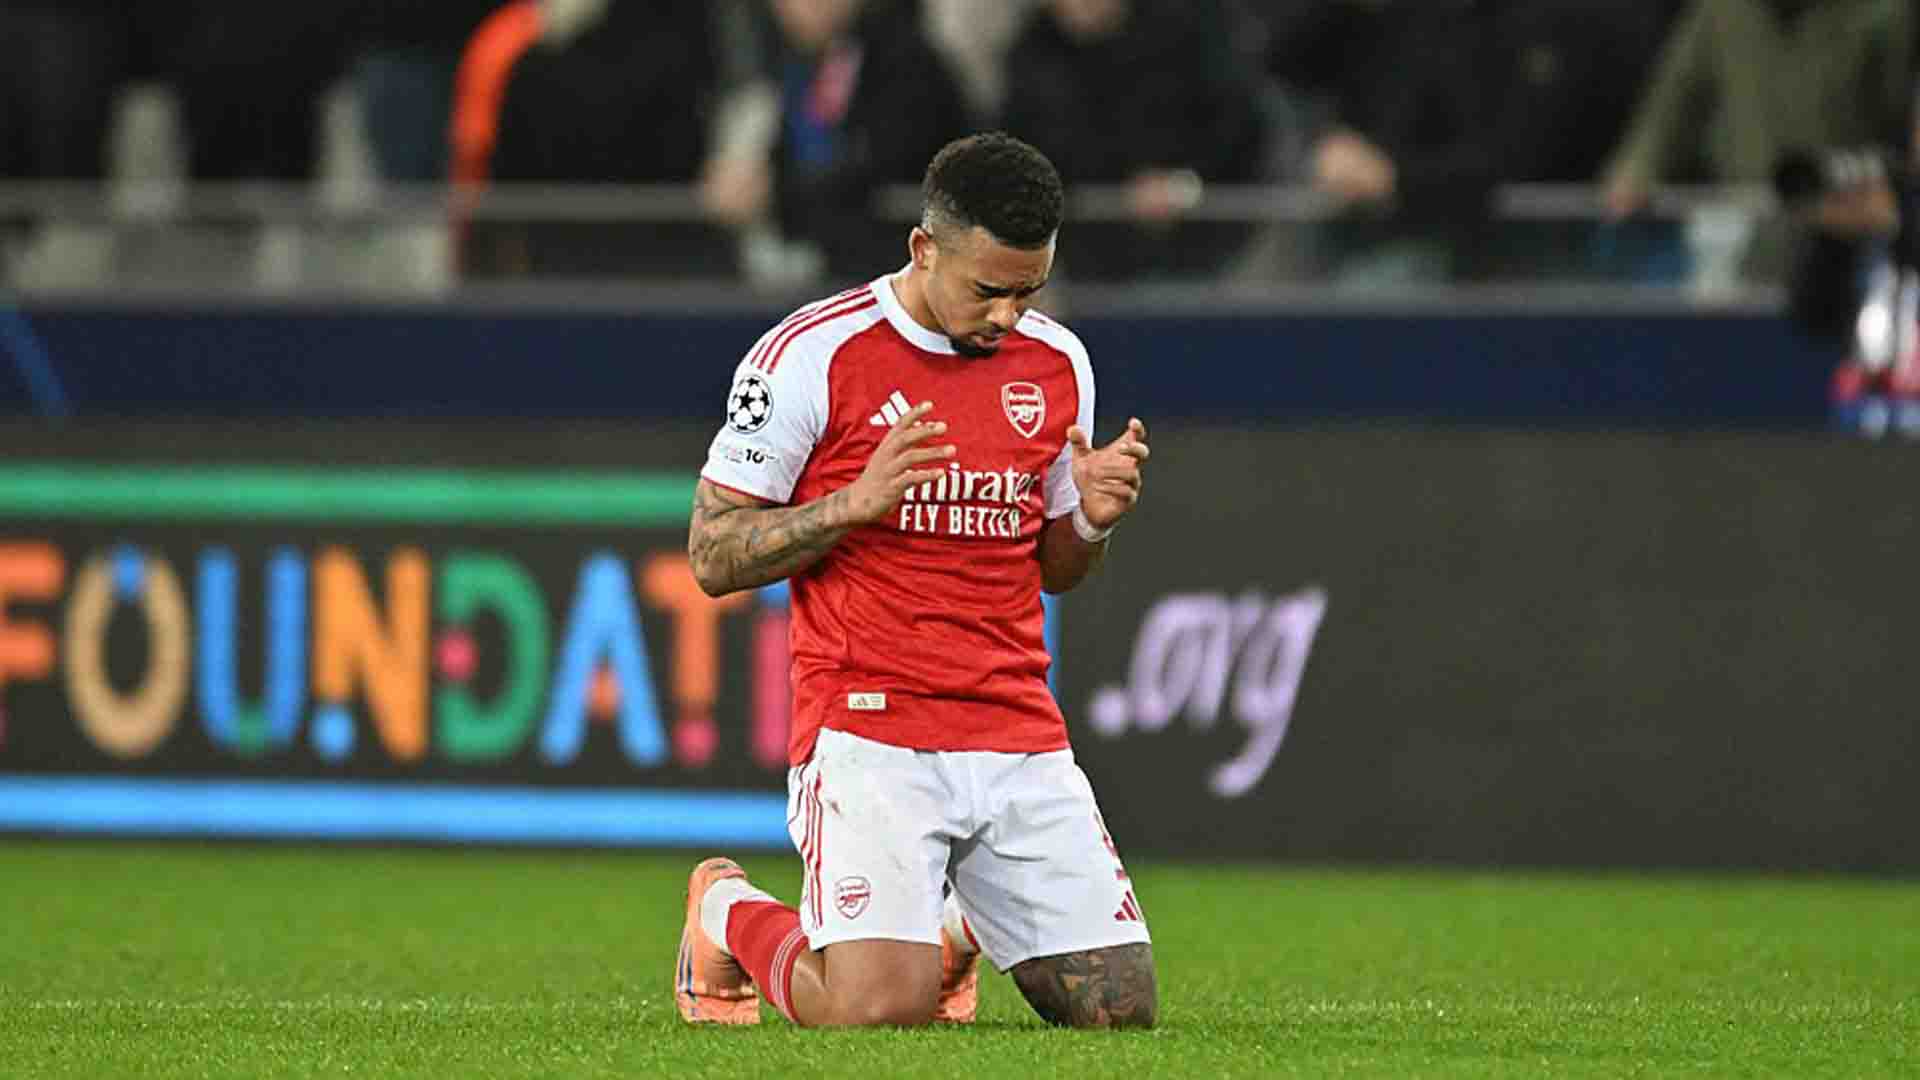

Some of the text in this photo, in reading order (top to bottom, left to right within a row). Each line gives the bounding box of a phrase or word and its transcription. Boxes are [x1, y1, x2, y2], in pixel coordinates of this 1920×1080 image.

[900, 504, 1020, 538] FLY BETTER
[0, 543, 790, 766] FOUNDATI
[1090, 589, 1326, 797] .org
